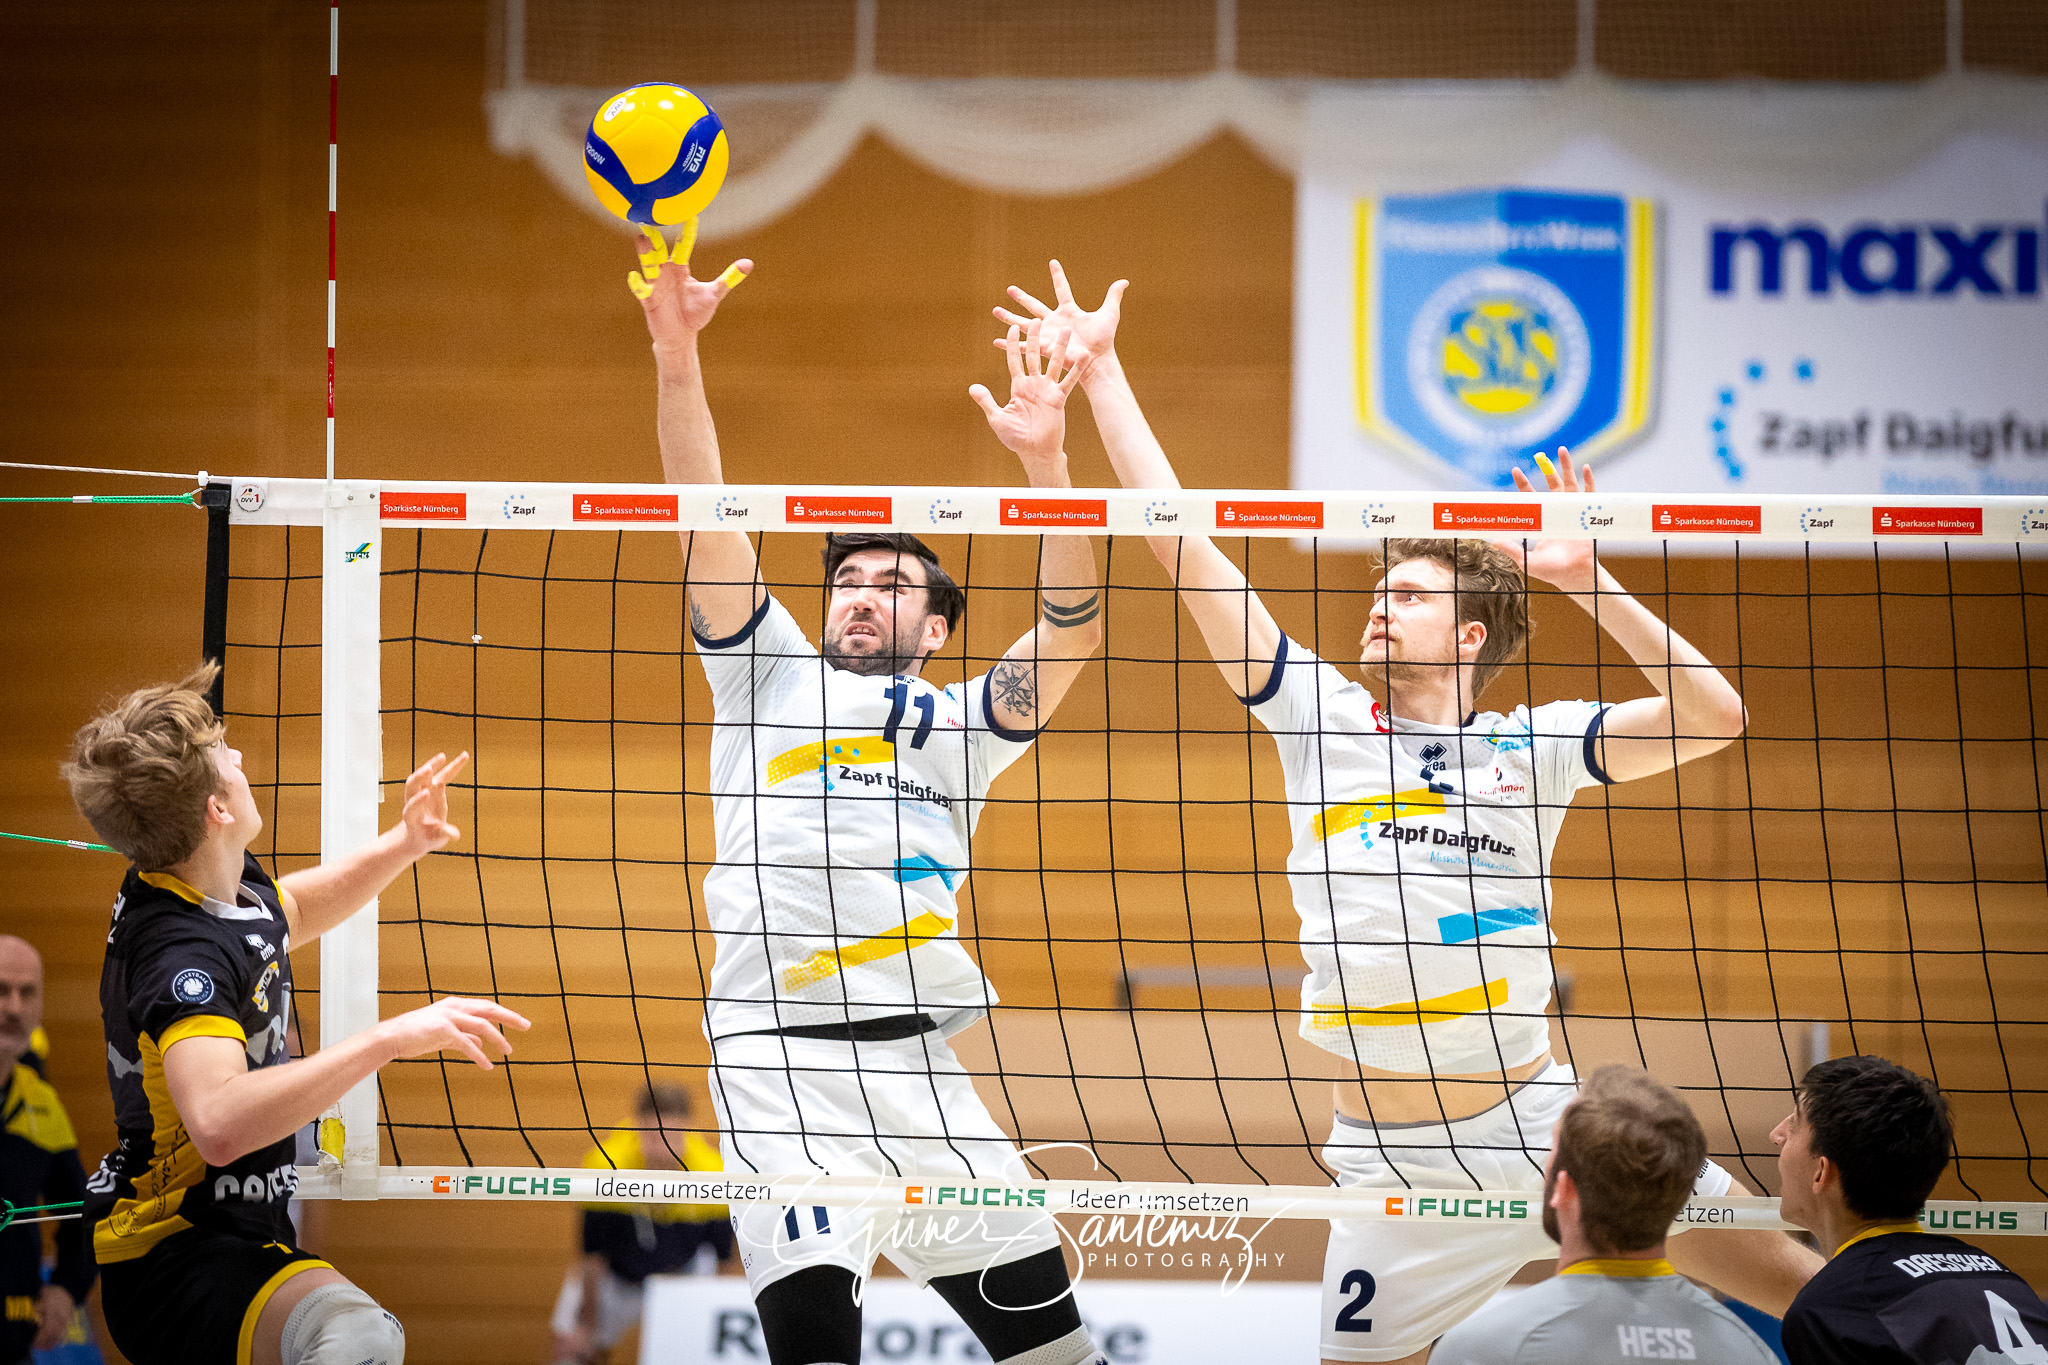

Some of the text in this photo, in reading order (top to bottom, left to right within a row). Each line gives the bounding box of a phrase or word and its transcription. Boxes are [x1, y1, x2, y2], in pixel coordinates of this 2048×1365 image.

[1710, 216, 2048, 296] maxi
[1759, 409, 1873, 464] Zapf
[383, 503, 459, 514] Sparkasse Nürnberg
[512, 505, 536, 517] Zapf
[594, 505, 634, 516] Sparkasse
[634, 505, 671, 517] Nürnberg
[724, 506, 749, 518] Zapf
[807, 507, 847, 518] Sparkasse
[848, 507, 885, 519] Nürnberg
[938, 509, 963, 521] Zapf
[1022, 509, 1062, 521] Sparkasse
[1062, 509, 1100, 521] Nürnberg
[1154, 512, 1178, 524] Zapf
[1238, 512, 1278, 523] Sparkasse
[1279, 512, 1316, 524] Nürnberg
[1371, 513, 1396, 525] Zapf
[1456, 514, 1496, 526] Sparkasse
[1497, 514, 1535, 526] Nürnberg
[1589, 516, 1614, 528] Zapf
[1674, 516, 1715, 528] Sparkasse
[1716, 516, 1754, 529] Nürnberg
[1809, 518, 1834, 530] Zapf
[1895, 519, 1936, 530] Sparkasse
[1937, 519, 1975, 531] Nürnberg
[882, 683, 935, 750] 11
[839, 765, 883, 787] Zapf
[1378, 821, 1429, 845] Zapf
[464, 1175, 771, 1200] FUCHS Ideen umsetzen
[938, 1186, 1046, 1207] FUCHS
[1070, 1187, 1130, 1209] Ideen
[1418, 1197, 1528, 1219] FUCHS
[1674, 1203, 1734, 1223] etzen
[1335, 1268, 1377, 1333] 2
[1983, 1289, 2048, 1365] 4
[1617, 1324, 1697, 1361] HESS
